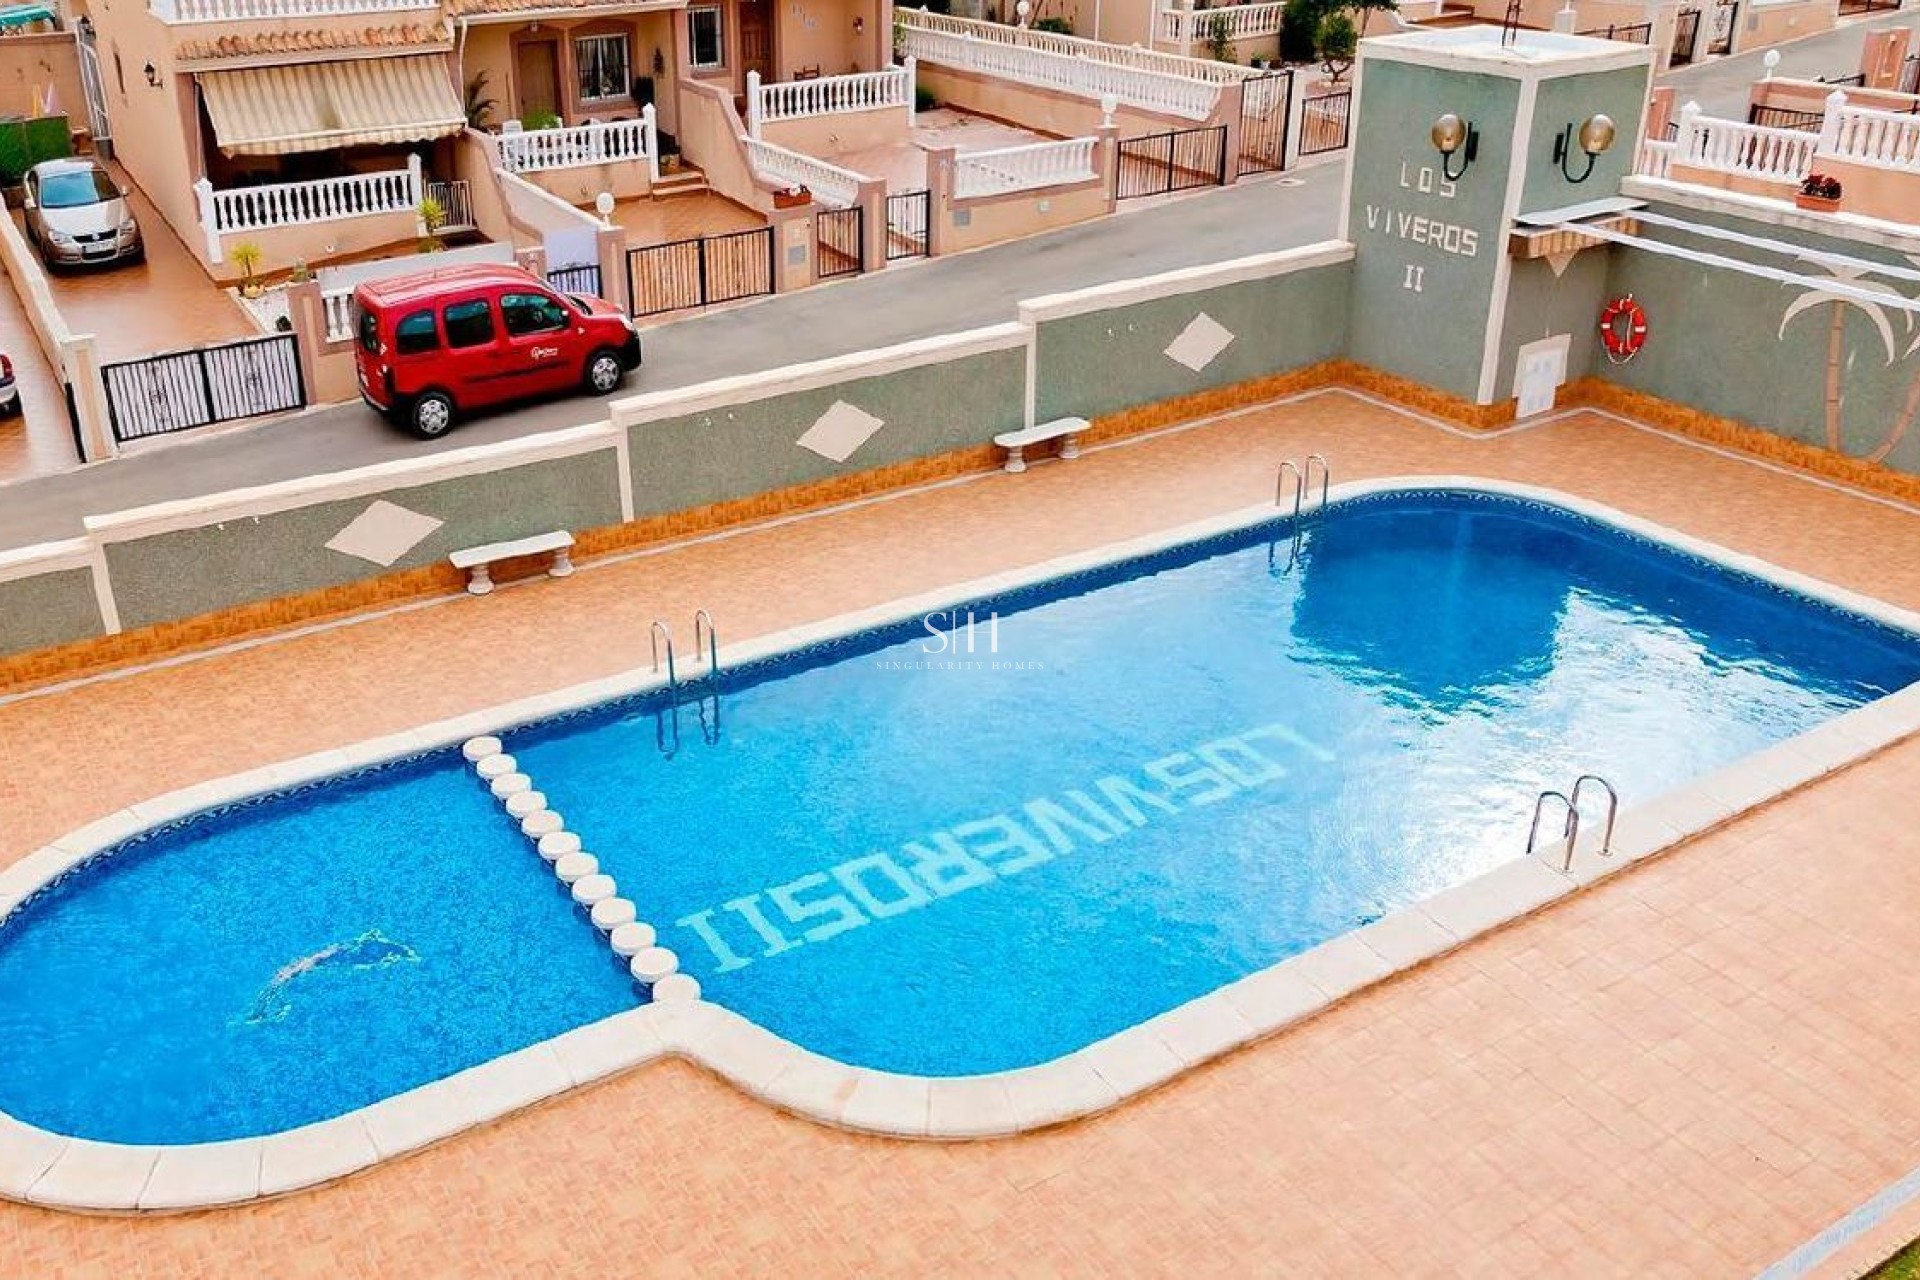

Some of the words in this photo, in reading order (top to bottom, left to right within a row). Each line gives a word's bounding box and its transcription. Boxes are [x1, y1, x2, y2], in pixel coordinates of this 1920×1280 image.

[1400, 160, 1456, 198] LOS
[1366, 204, 1479, 257] VIVEROS
[1403, 264, 1425, 292] II
